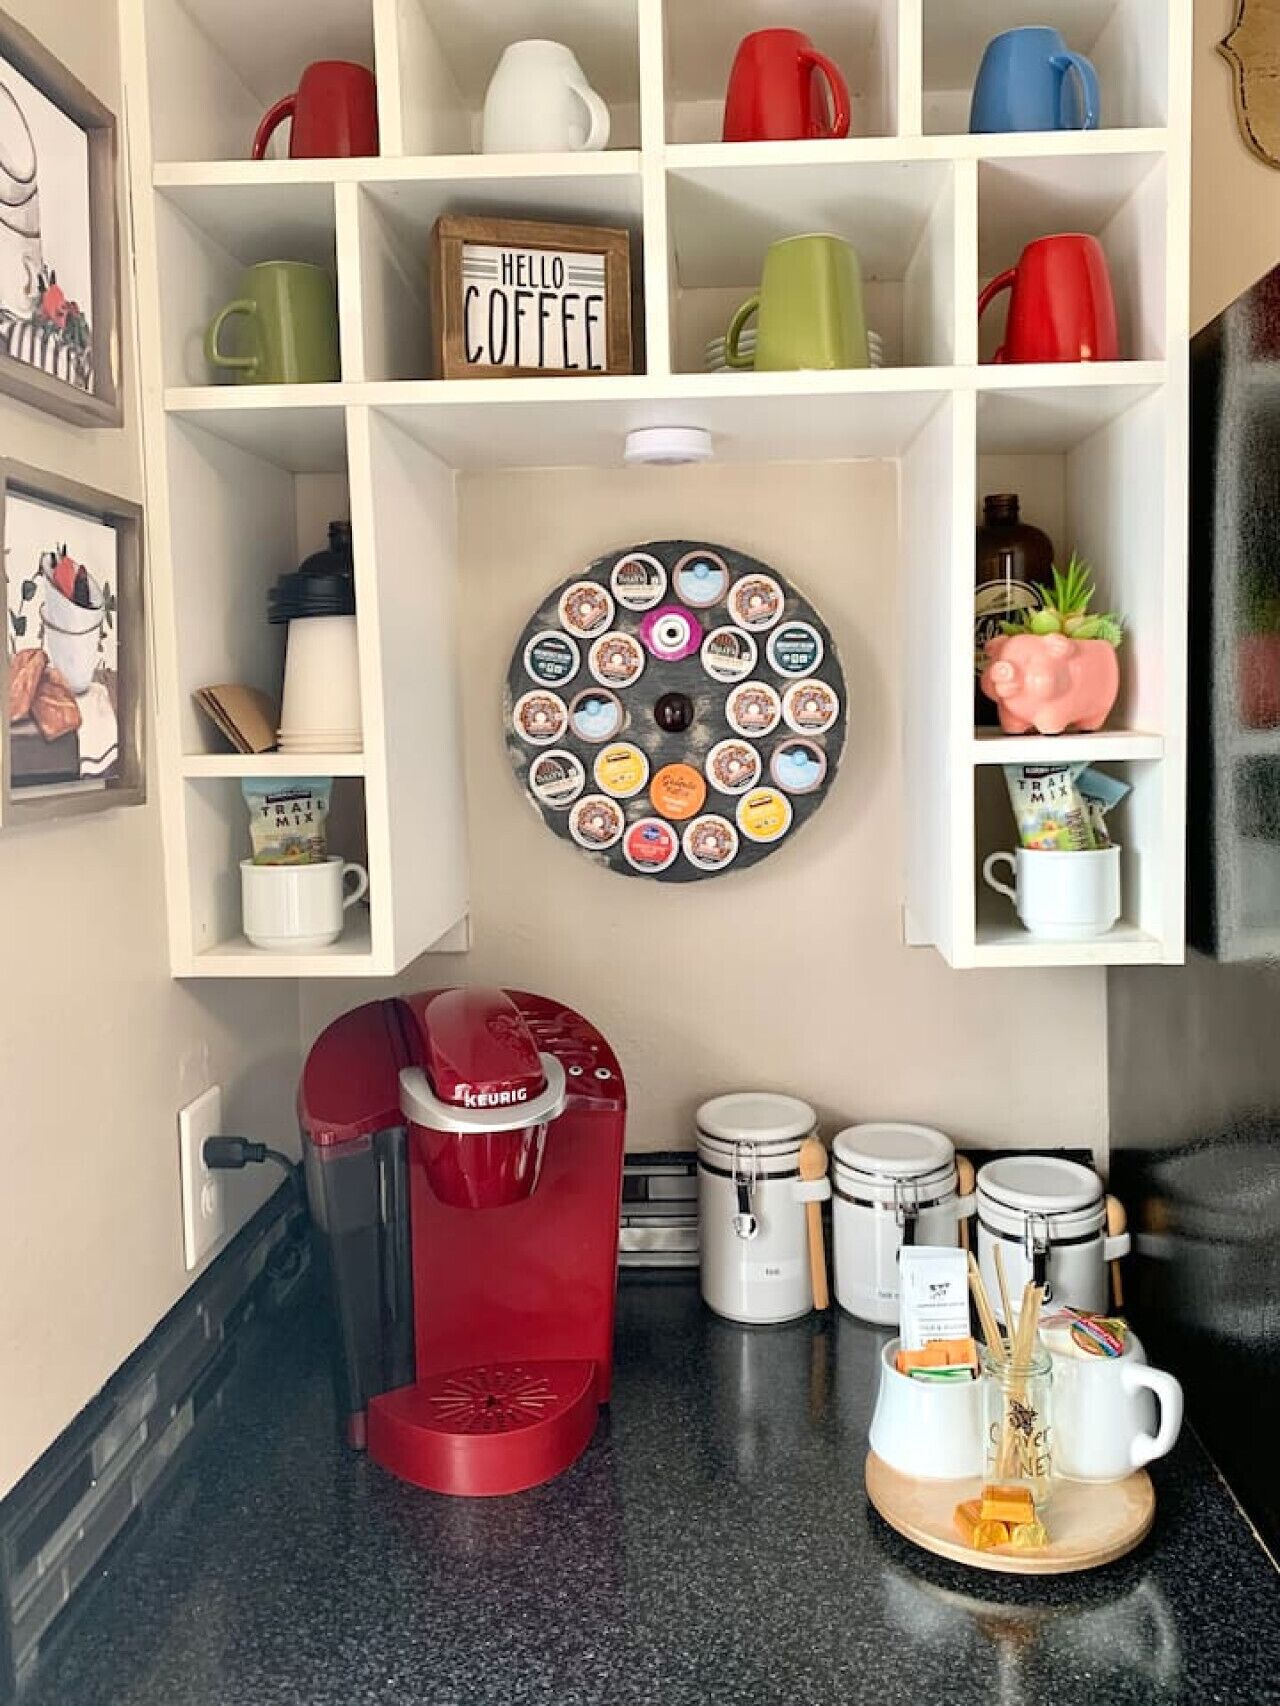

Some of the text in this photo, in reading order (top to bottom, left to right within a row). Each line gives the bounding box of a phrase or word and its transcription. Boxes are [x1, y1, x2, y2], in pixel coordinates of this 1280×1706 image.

[501, 253, 565, 289] HELLO
[463, 285, 604, 371] COFFEE
[1030, 784, 1068, 803] MIX
[260, 799, 326, 818] TRAIL
[275, 811, 314, 828] MIX
[464, 1087, 527, 1108] KEURIG
